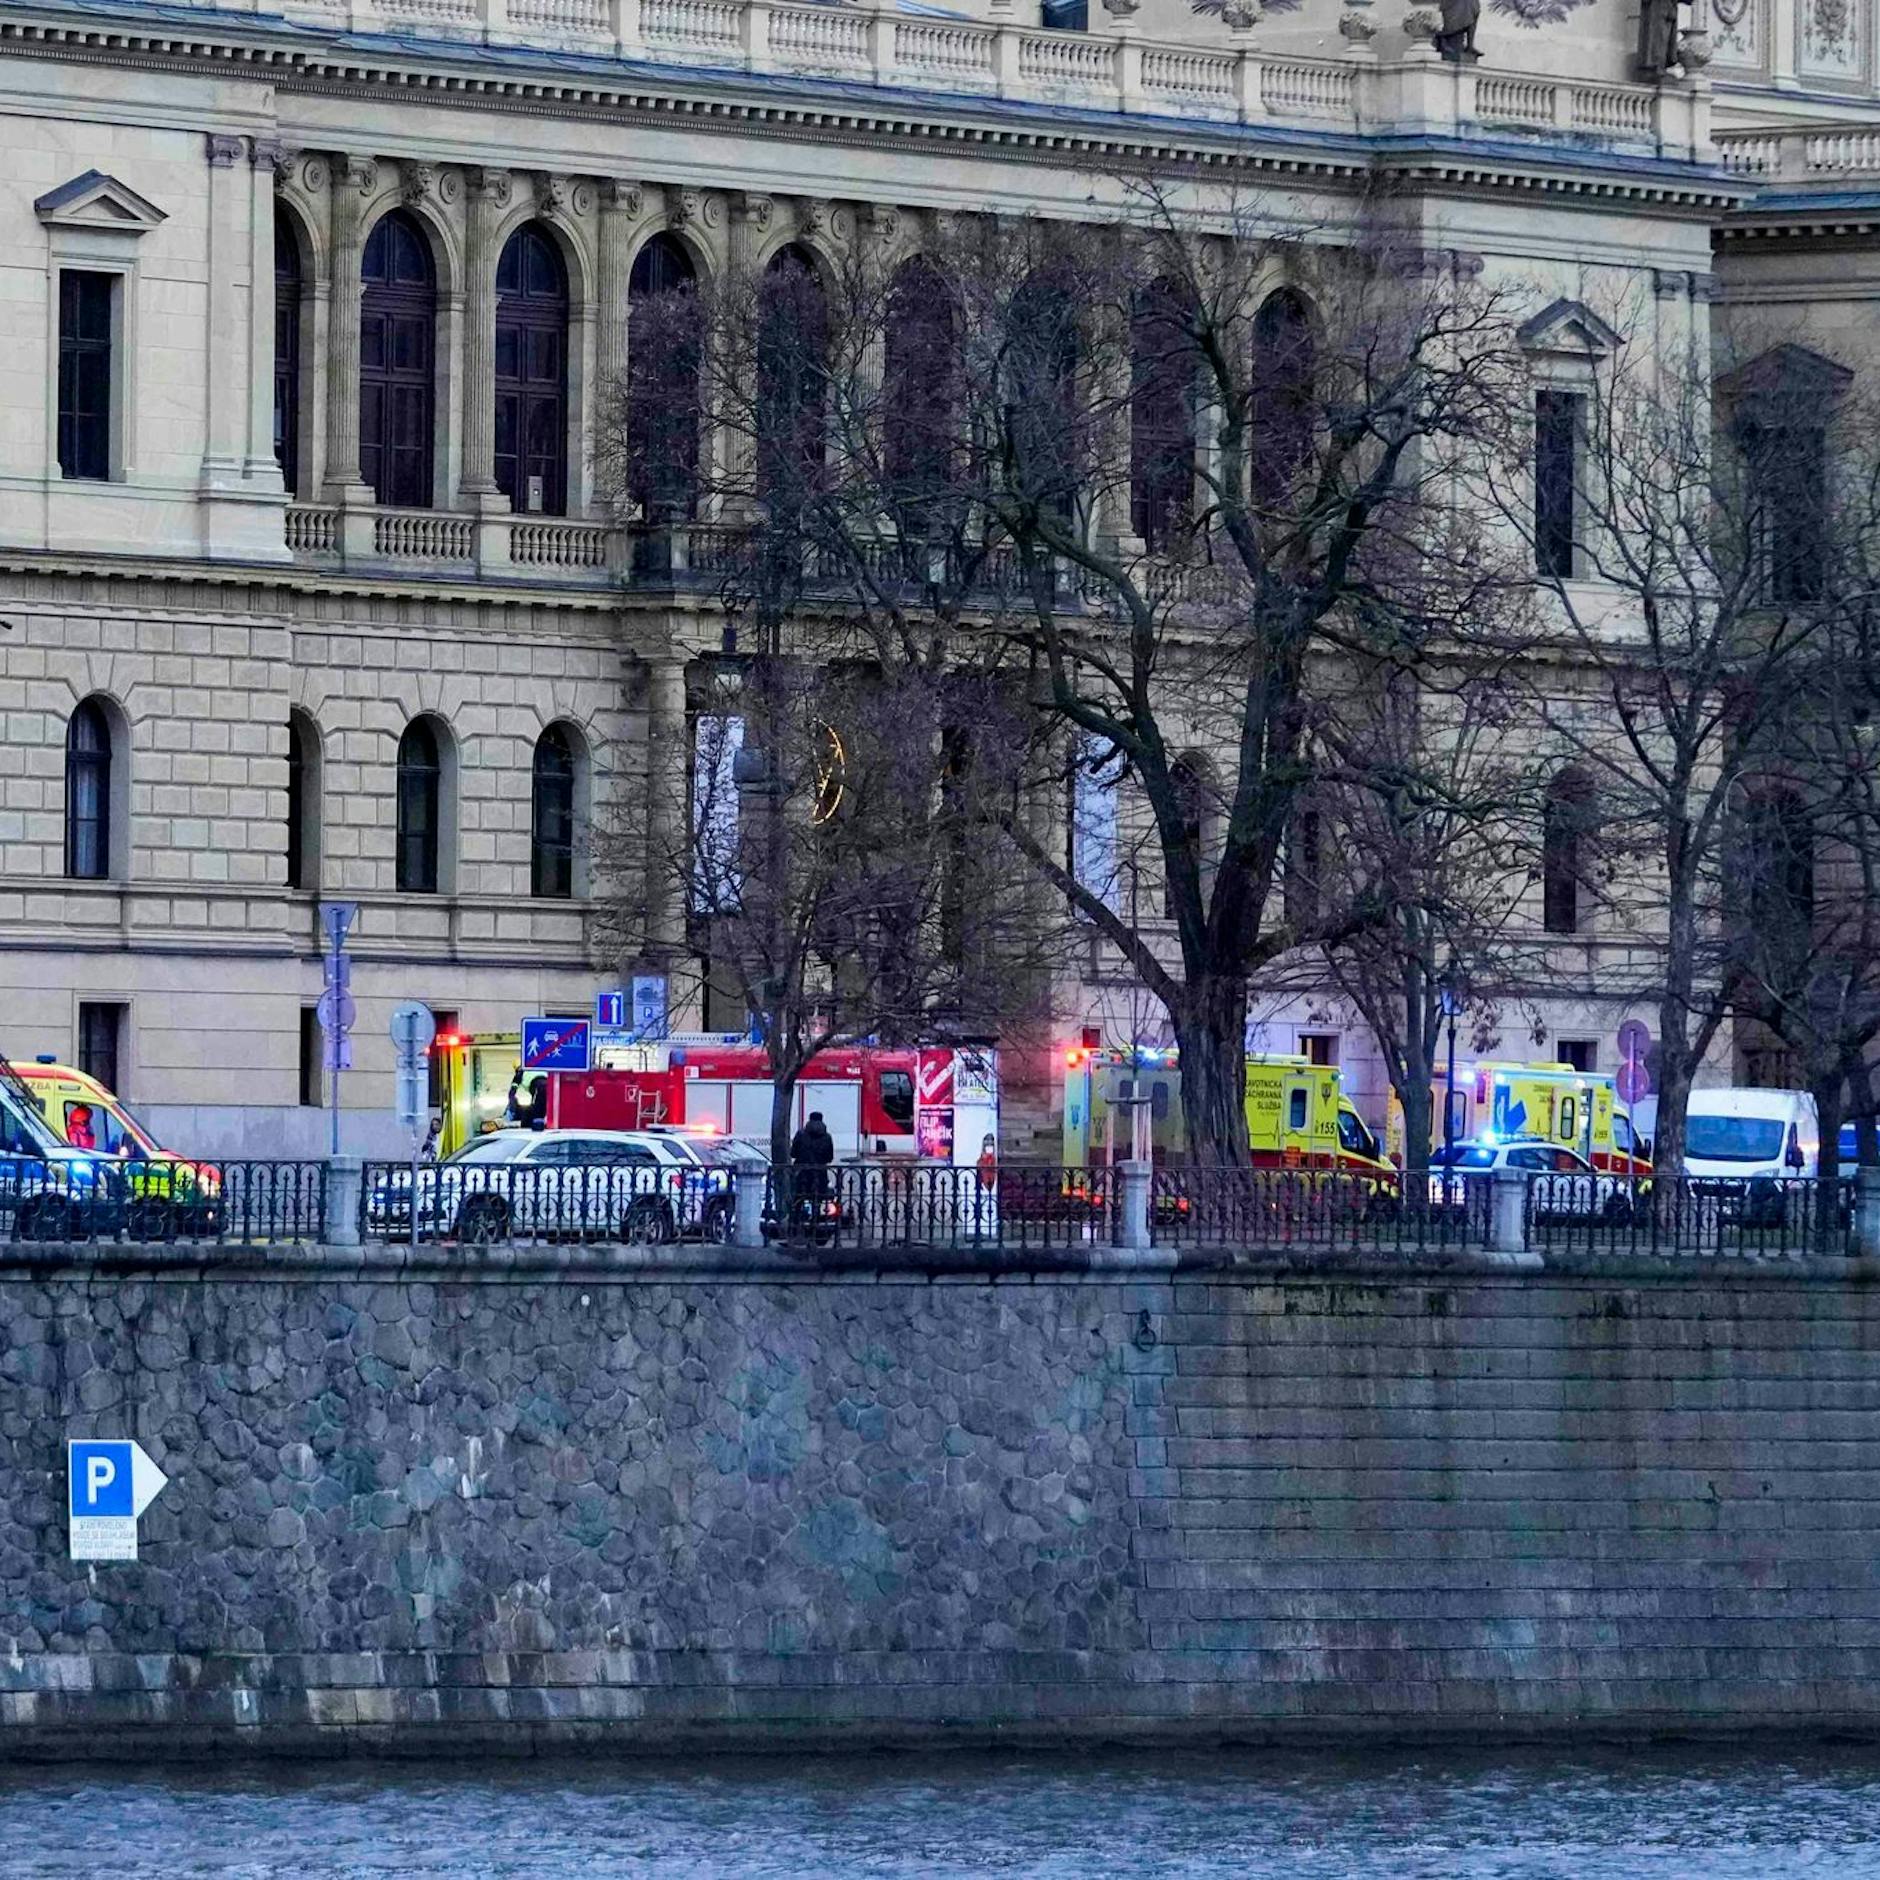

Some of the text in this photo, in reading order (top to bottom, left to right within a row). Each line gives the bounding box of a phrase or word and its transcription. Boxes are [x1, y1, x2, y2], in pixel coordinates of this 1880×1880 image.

[645, 1008, 652, 1017] P
[1321, 1121, 1335, 1135] 155
[87, 1456, 116, 1504] P
